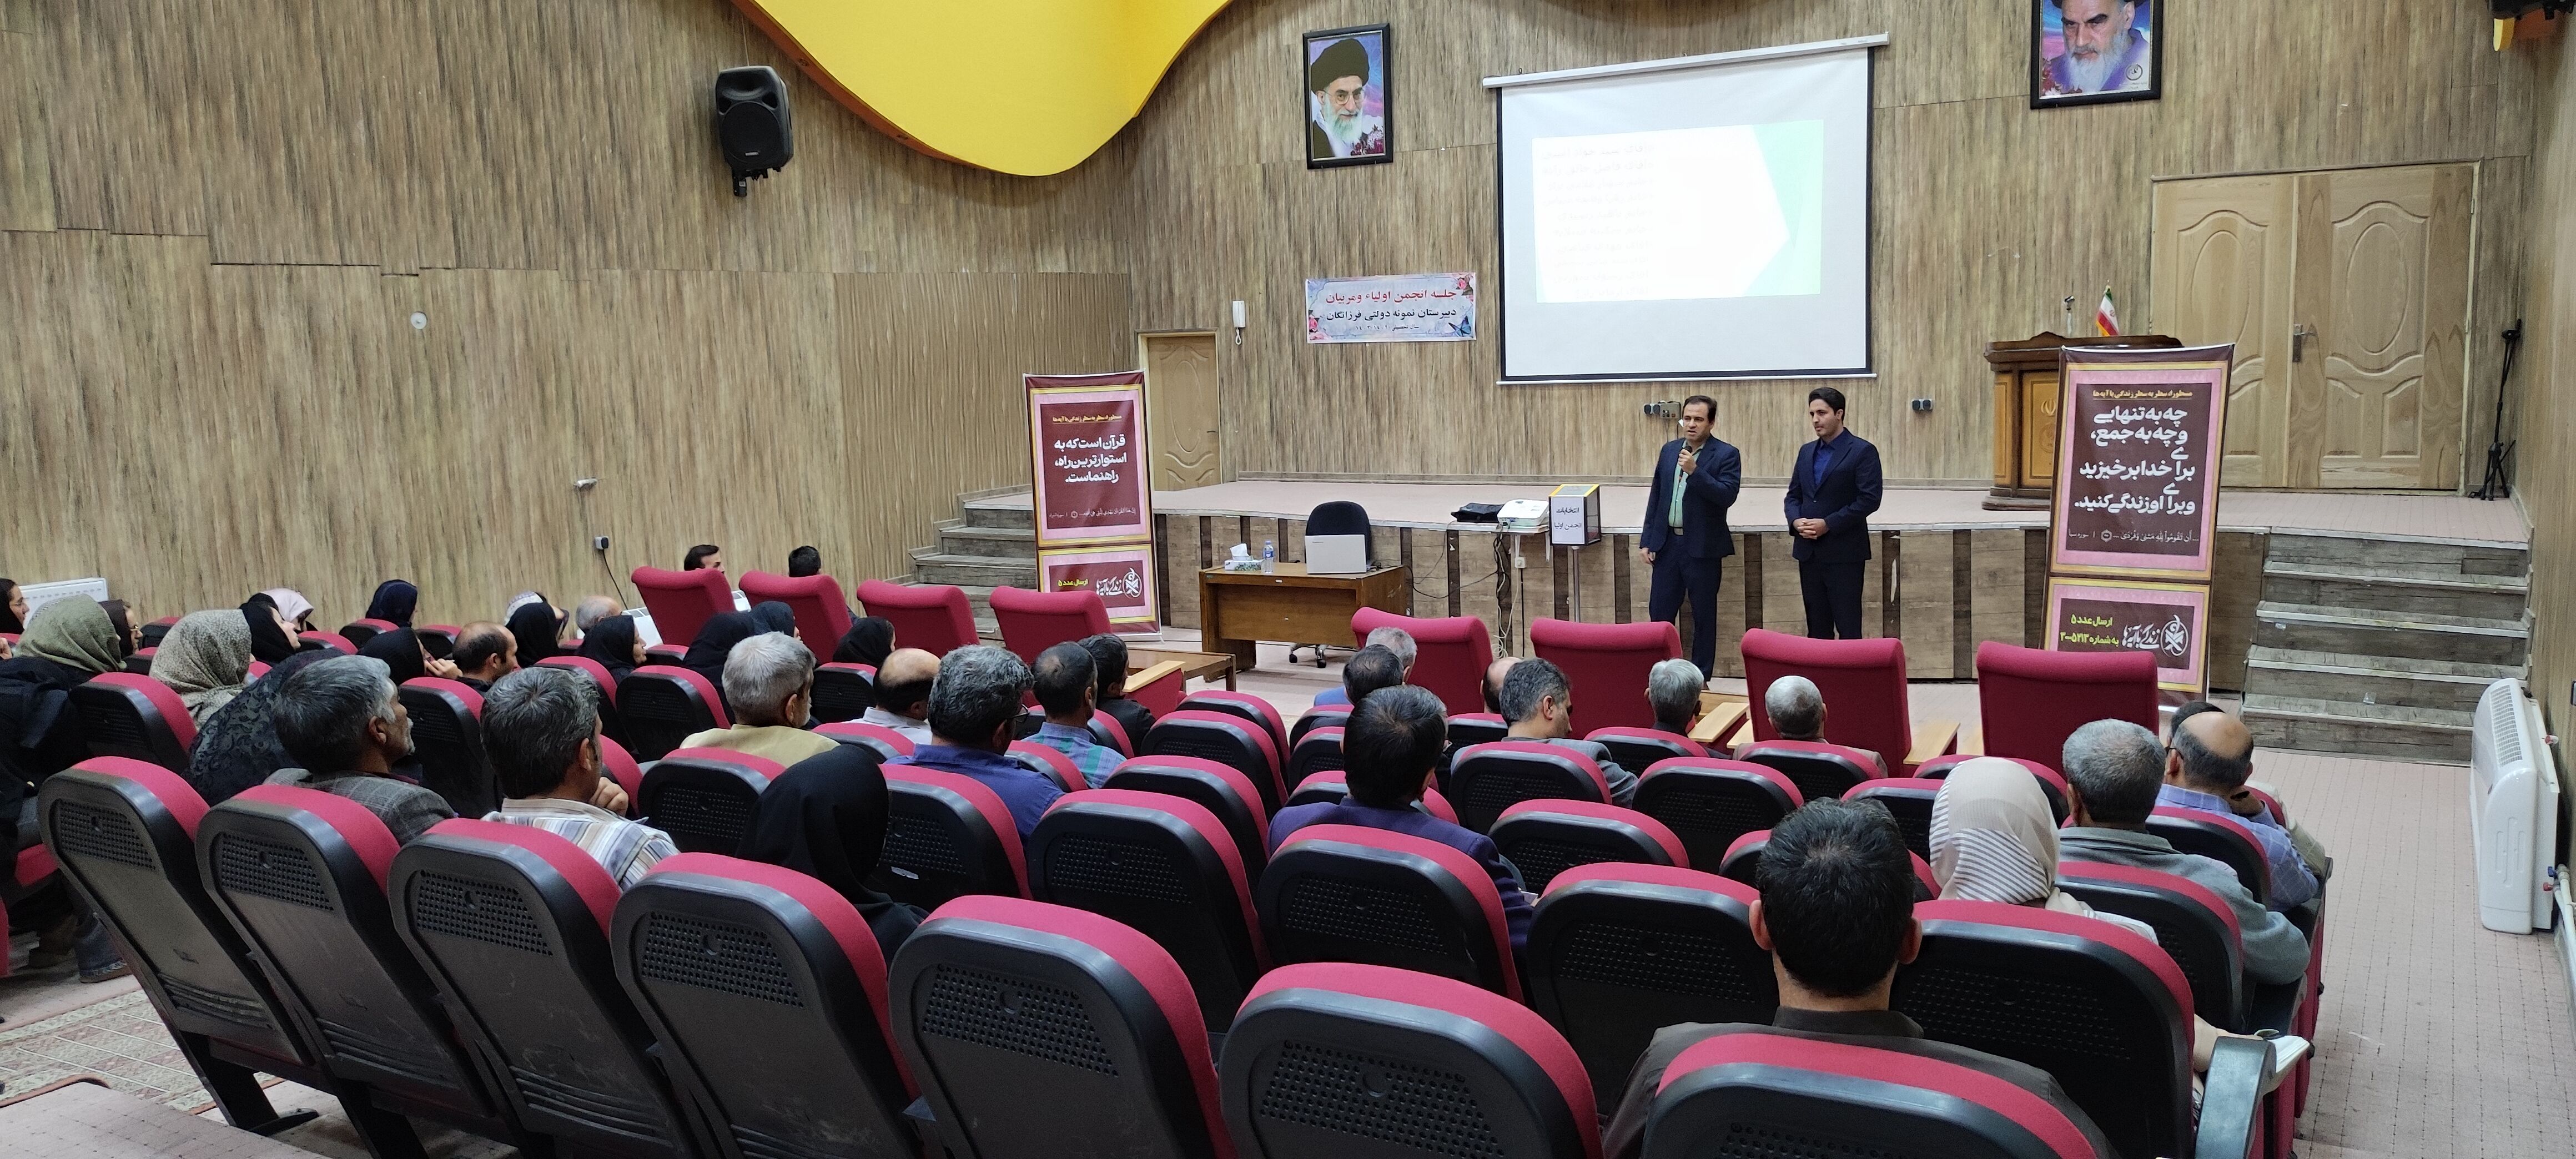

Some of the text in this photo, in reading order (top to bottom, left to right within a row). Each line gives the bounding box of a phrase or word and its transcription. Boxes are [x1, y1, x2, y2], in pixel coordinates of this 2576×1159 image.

[1394, 290, 1427, 303] انجمن
[1431, 289, 1457, 299] جلسه
[1326, 309, 1457, 321] دبیرستان نمونه دولتی فرزانگان
[2094, 406, 2188, 427] چه به تنهایی
[2134, 426, 2152, 445] به
[1054, 434, 1126, 452] قرآن است که به
[1070, 452, 1127, 469] استوارترین
[2141, 460, 2172, 477] خدا
[2107, 493, 2150, 513] زندگی
[1556, 507, 1579, 515] انتخابات
[2076, 616, 2092, 625] عدد
[2092, 616, 2113, 627] ارسال
[2089, 634, 2111, 645] شماره
[2111, 637, 2120, 647] به
